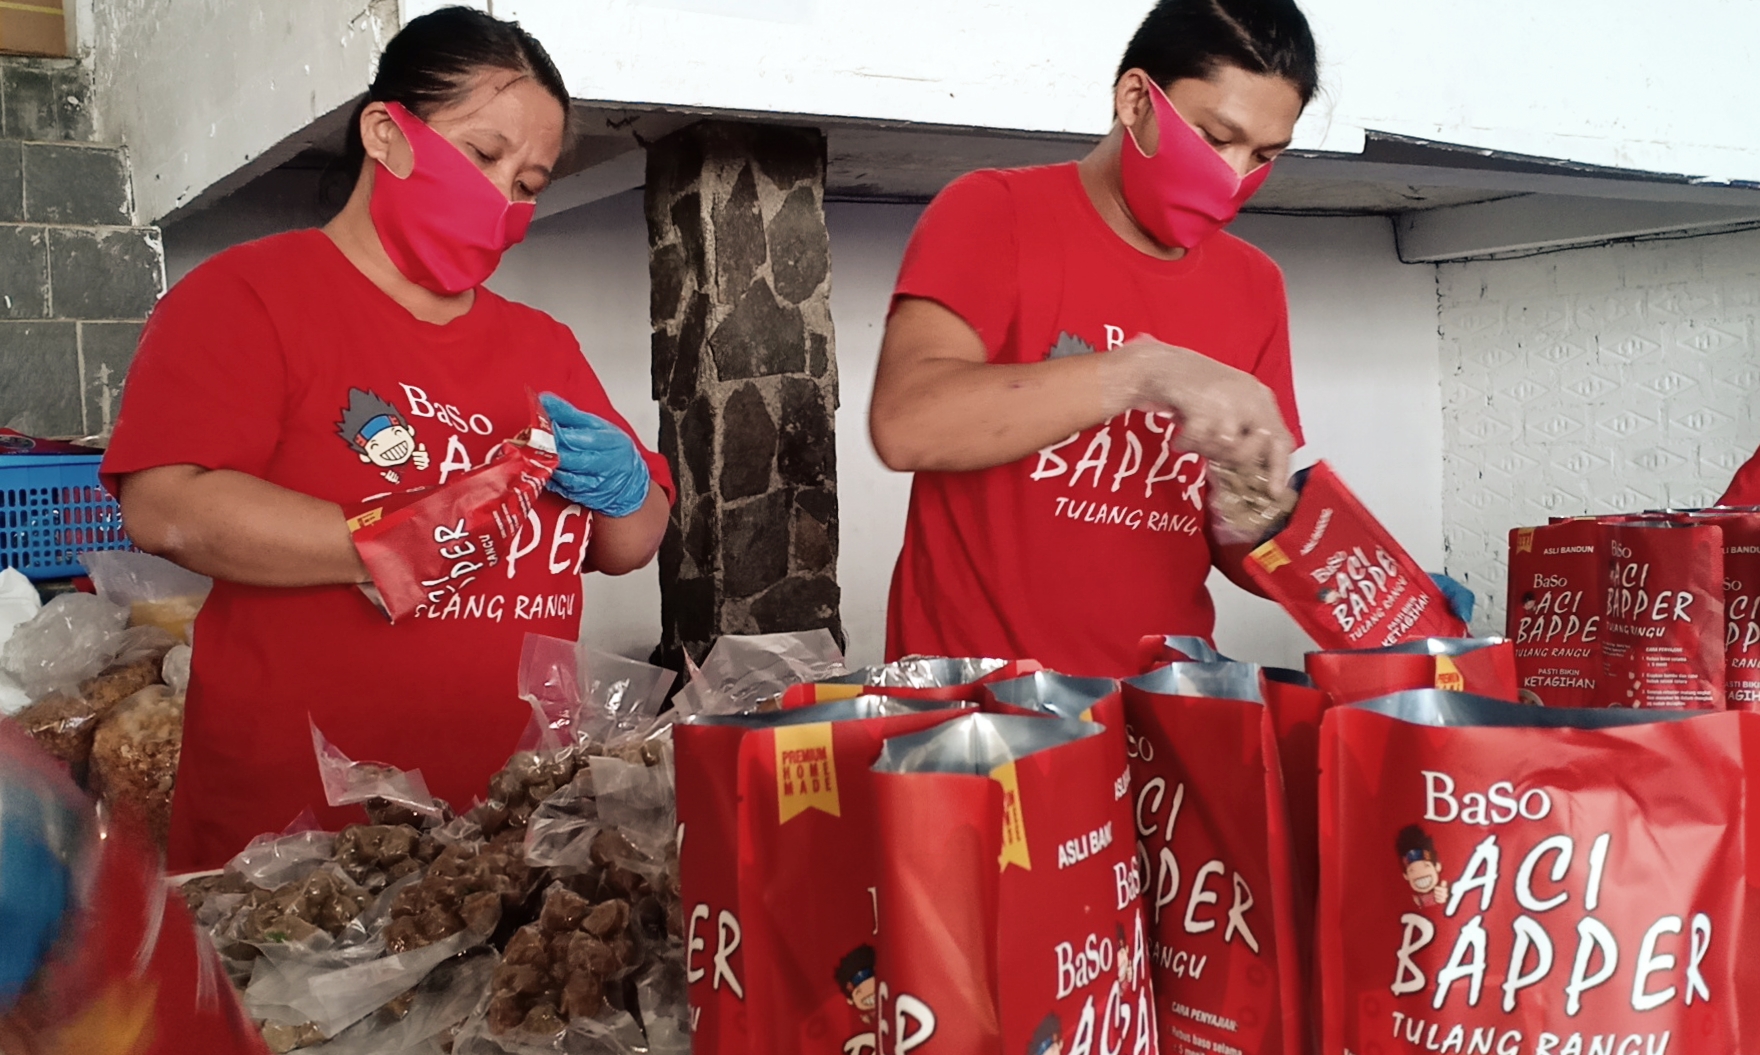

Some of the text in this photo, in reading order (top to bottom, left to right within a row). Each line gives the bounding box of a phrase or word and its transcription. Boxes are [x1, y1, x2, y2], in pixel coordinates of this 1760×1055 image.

[1055, 497, 1200, 536] TULANG RANG
[1560, 546, 1594, 554] BANDUN
[514, 593, 575, 619] RANGU
[1535, 591, 1583, 615] ACI
[1606, 588, 1694, 622] BAPPER
[1516, 615, 1600, 644] BAPPE
[1551, 648, 1591, 658] RANGU
[1524, 676, 1596, 689] KETAGIHAN
[782, 746, 827, 764] PREMIUM
[783, 761, 829, 780] HOME
[784, 777, 831, 796] MADE
[1421, 770, 1551, 825] BaSo
[1137, 777, 1184, 841] CI
[1059, 831, 1089, 869] ASLI
[1445, 833, 1611, 917] ACI
[1055, 933, 1112, 1000] BaSo
[1390, 912, 1712, 1017] BAPPER
[1391, 1011, 1523, 1055] TULANG
